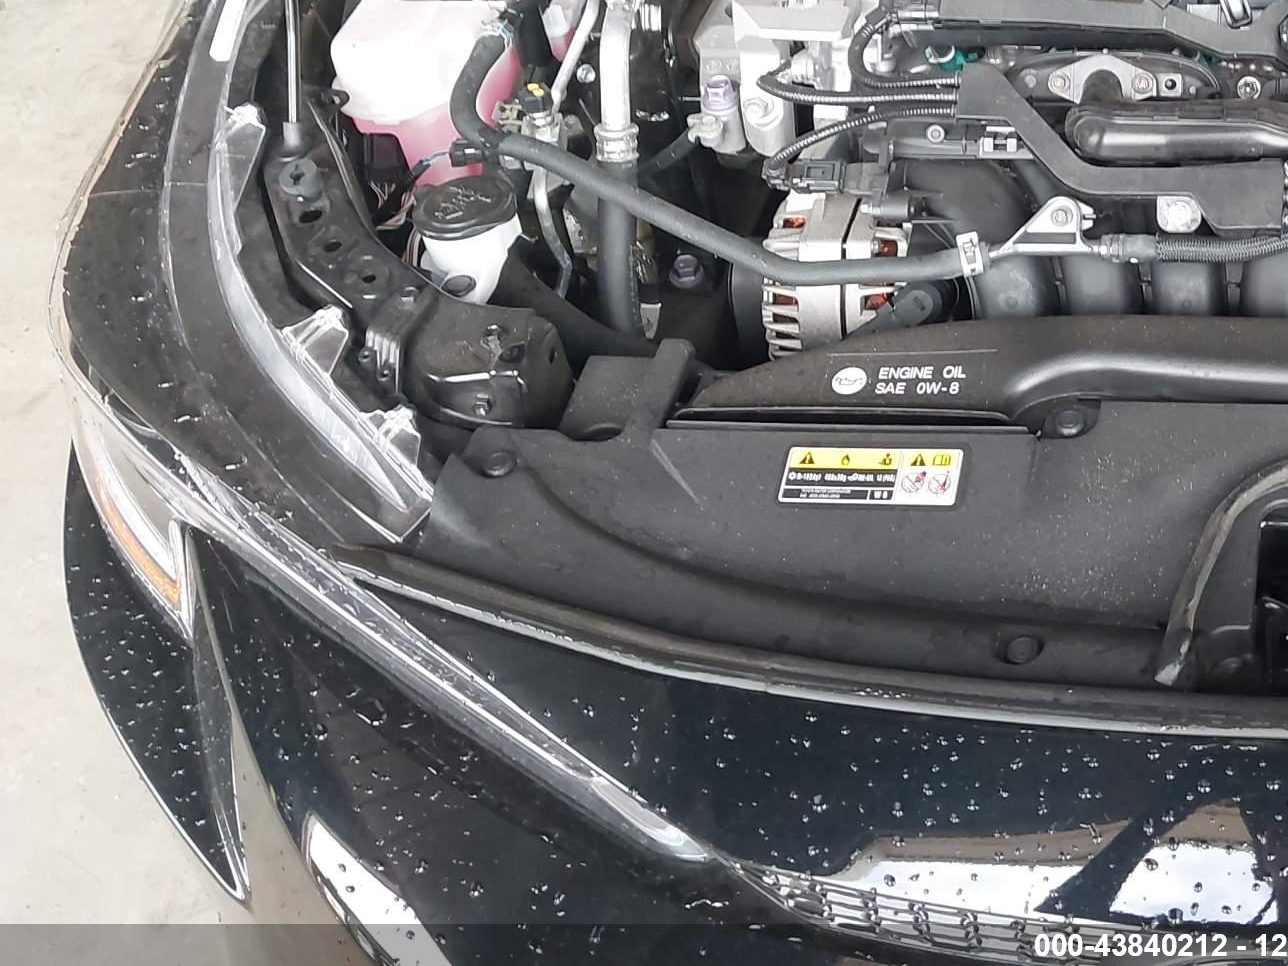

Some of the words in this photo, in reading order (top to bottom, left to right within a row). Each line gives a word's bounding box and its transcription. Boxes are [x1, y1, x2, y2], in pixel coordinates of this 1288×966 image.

[878, 366, 935, 380] ENGINE
[942, 365, 966, 379] OIL
[874, 381, 907, 395] SAE
[916, 381, 960, 395] 0W-8
